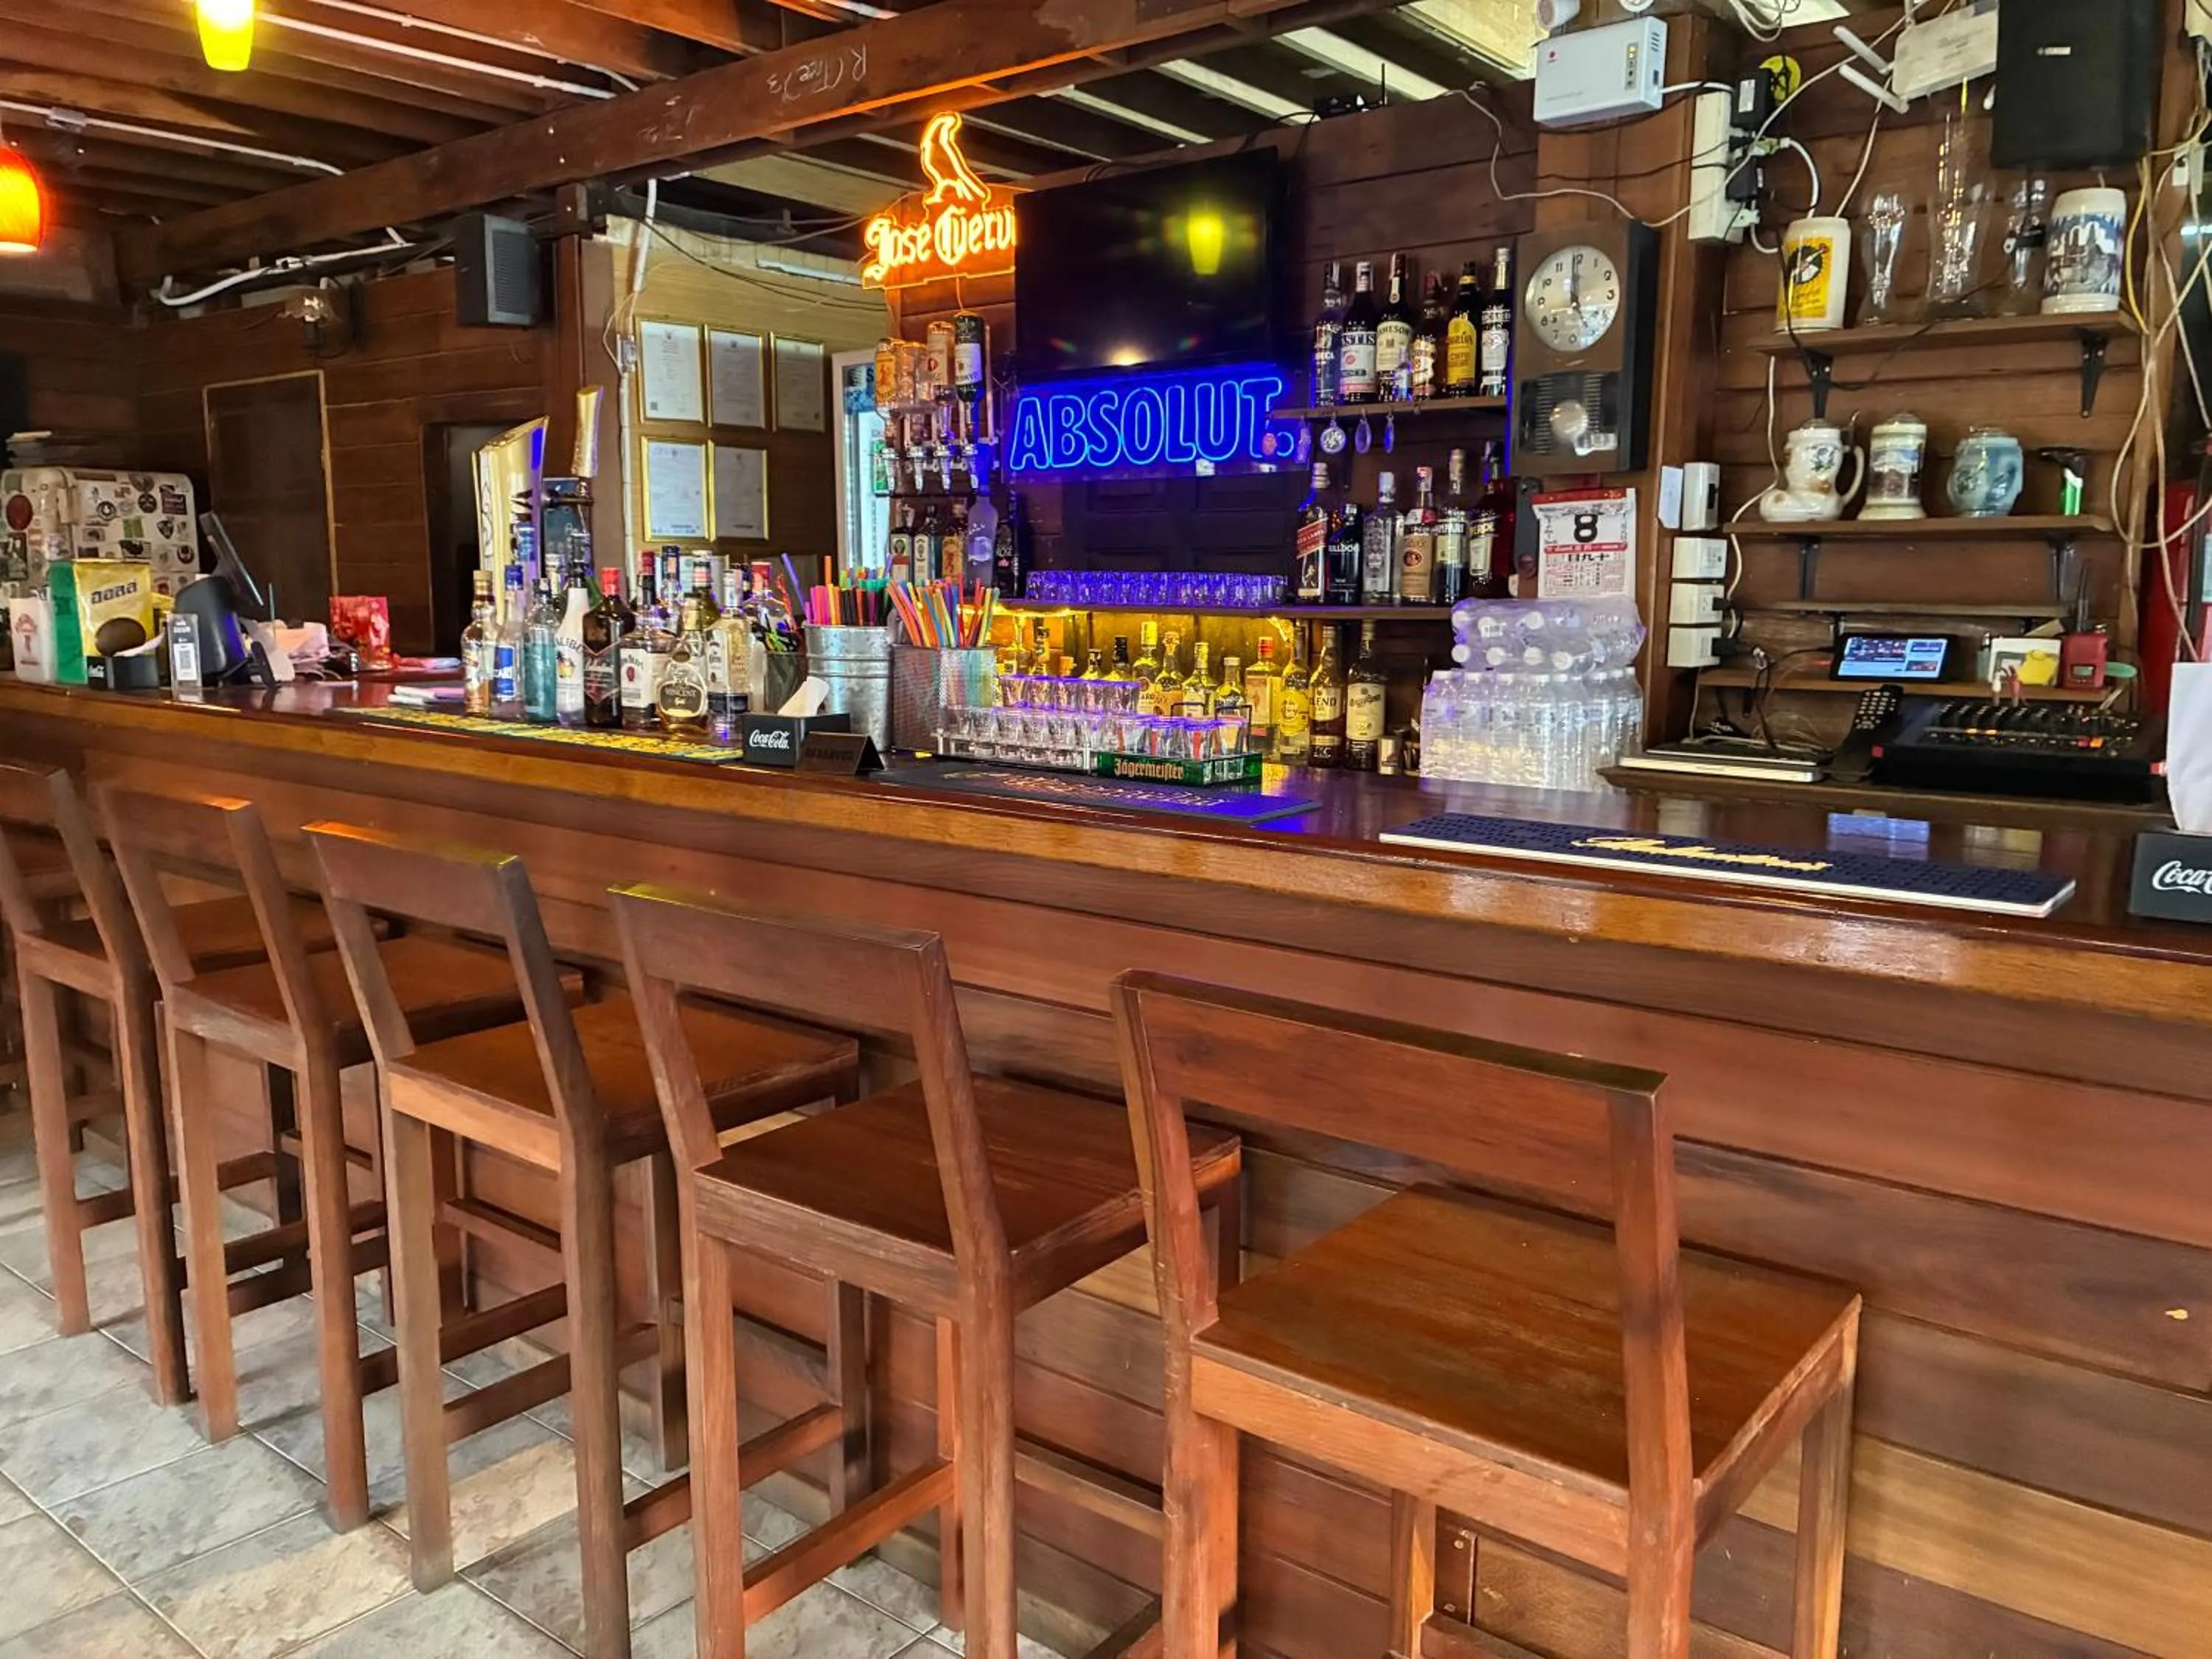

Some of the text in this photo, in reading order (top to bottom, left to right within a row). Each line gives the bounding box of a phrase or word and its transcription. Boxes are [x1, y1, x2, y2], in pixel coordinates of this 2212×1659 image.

[933, 204, 1016, 266] Cuerv
[1573, 514, 1598, 543] 8
[555, 637, 582, 653] ALIBU
[1114, 757, 1185, 781] Jägermeister
